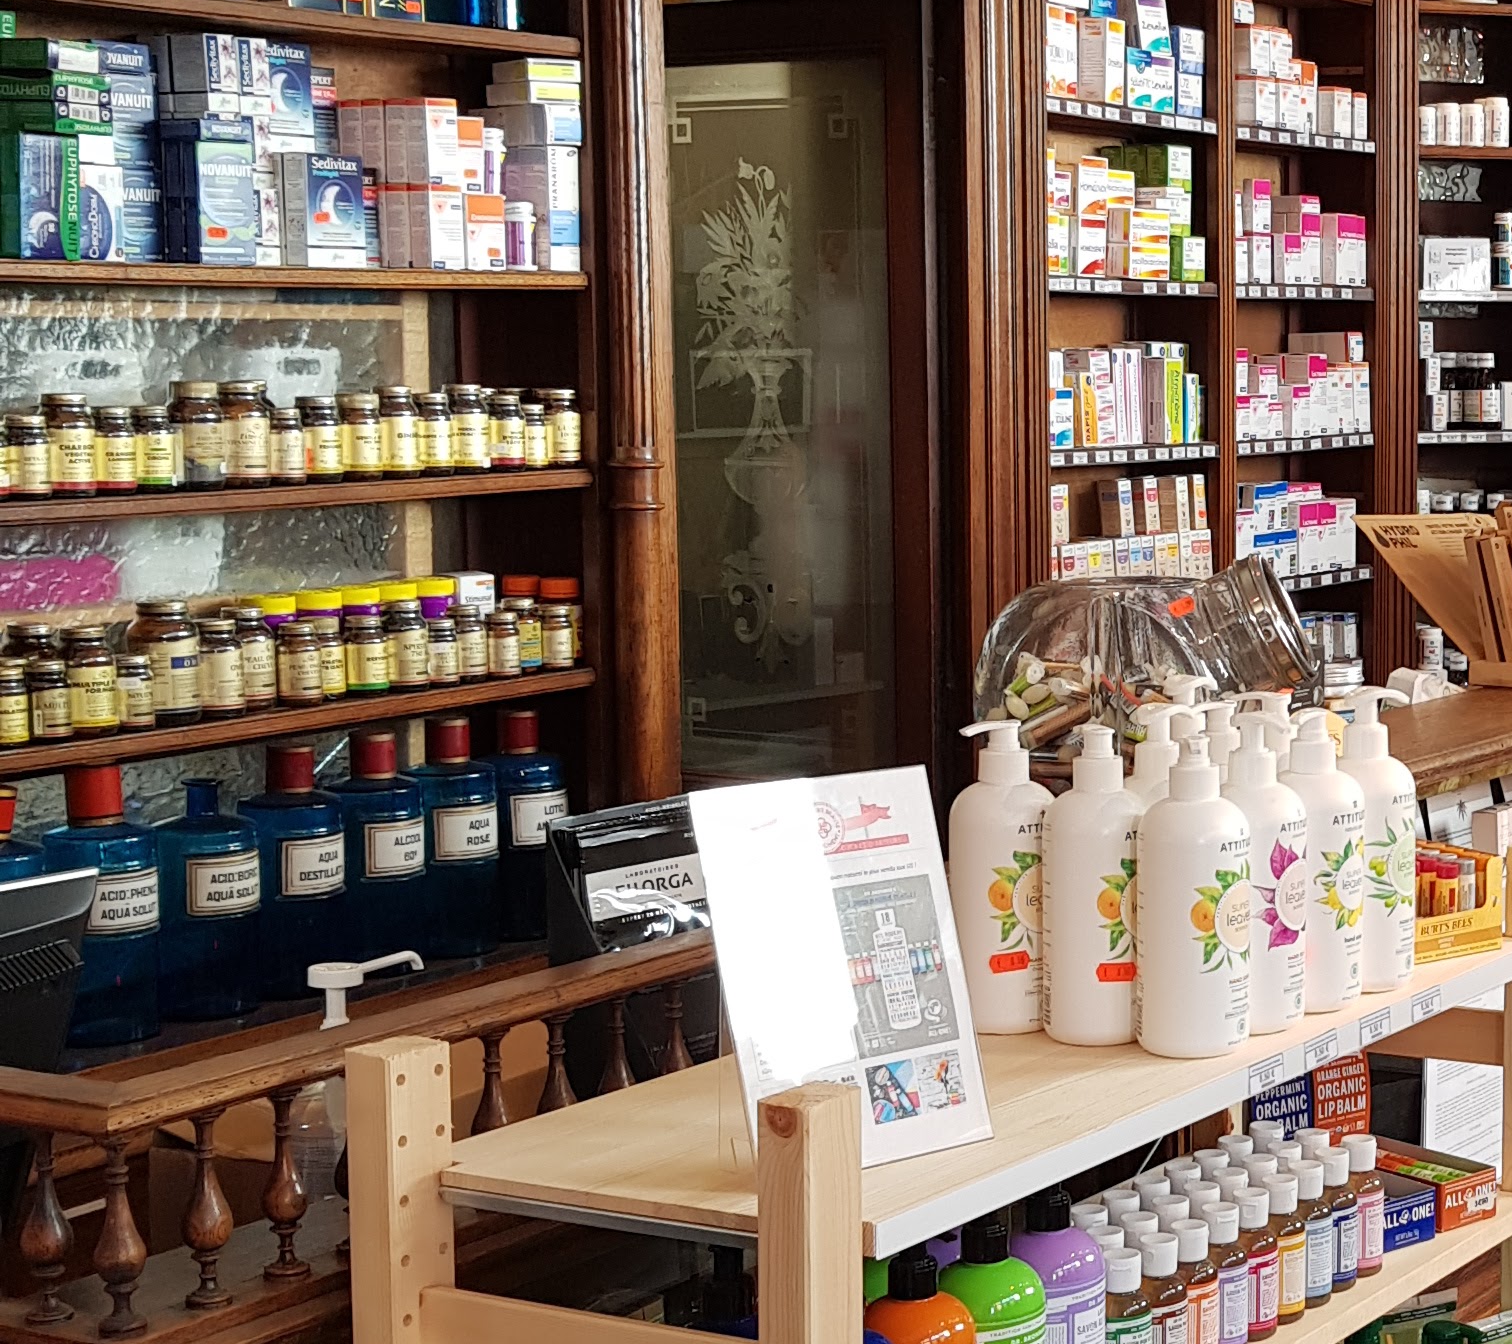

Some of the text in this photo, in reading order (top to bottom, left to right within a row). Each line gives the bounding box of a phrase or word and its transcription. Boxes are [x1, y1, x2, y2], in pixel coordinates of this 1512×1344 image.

[264, 46, 305, 60] edivitax
[200, 162, 251, 178] NOVANUIT
[311, 155, 358, 172] Sedivitax
[66, 138, 78, 256] EUPHYTOSE NUIT
[1379, 525, 1420, 536] HYDRO
[1389, 537, 1418, 549] PHIL
[468, 817, 490, 831] AQUA
[1332, 811, 1364, 826] ATTITU
[466, 833, 491, 846] ROSE
[318, 850, 339, 863] AQUA
[1420, 917, 1474, 935] BURT'S BEES
[1316, 1062, 1365, 1082] ORANGE GINGER
[1255, 1080, 1305, 1102] PEPPERMINT
[1317, 1075, 1367, 1101] ORGANIC
[1256, 1094, 1308, 1120] ORGANIC
[1318, 1094, 1366, 1119] LIP BALM
[1445, 1192, 1465, 1209] ALL
